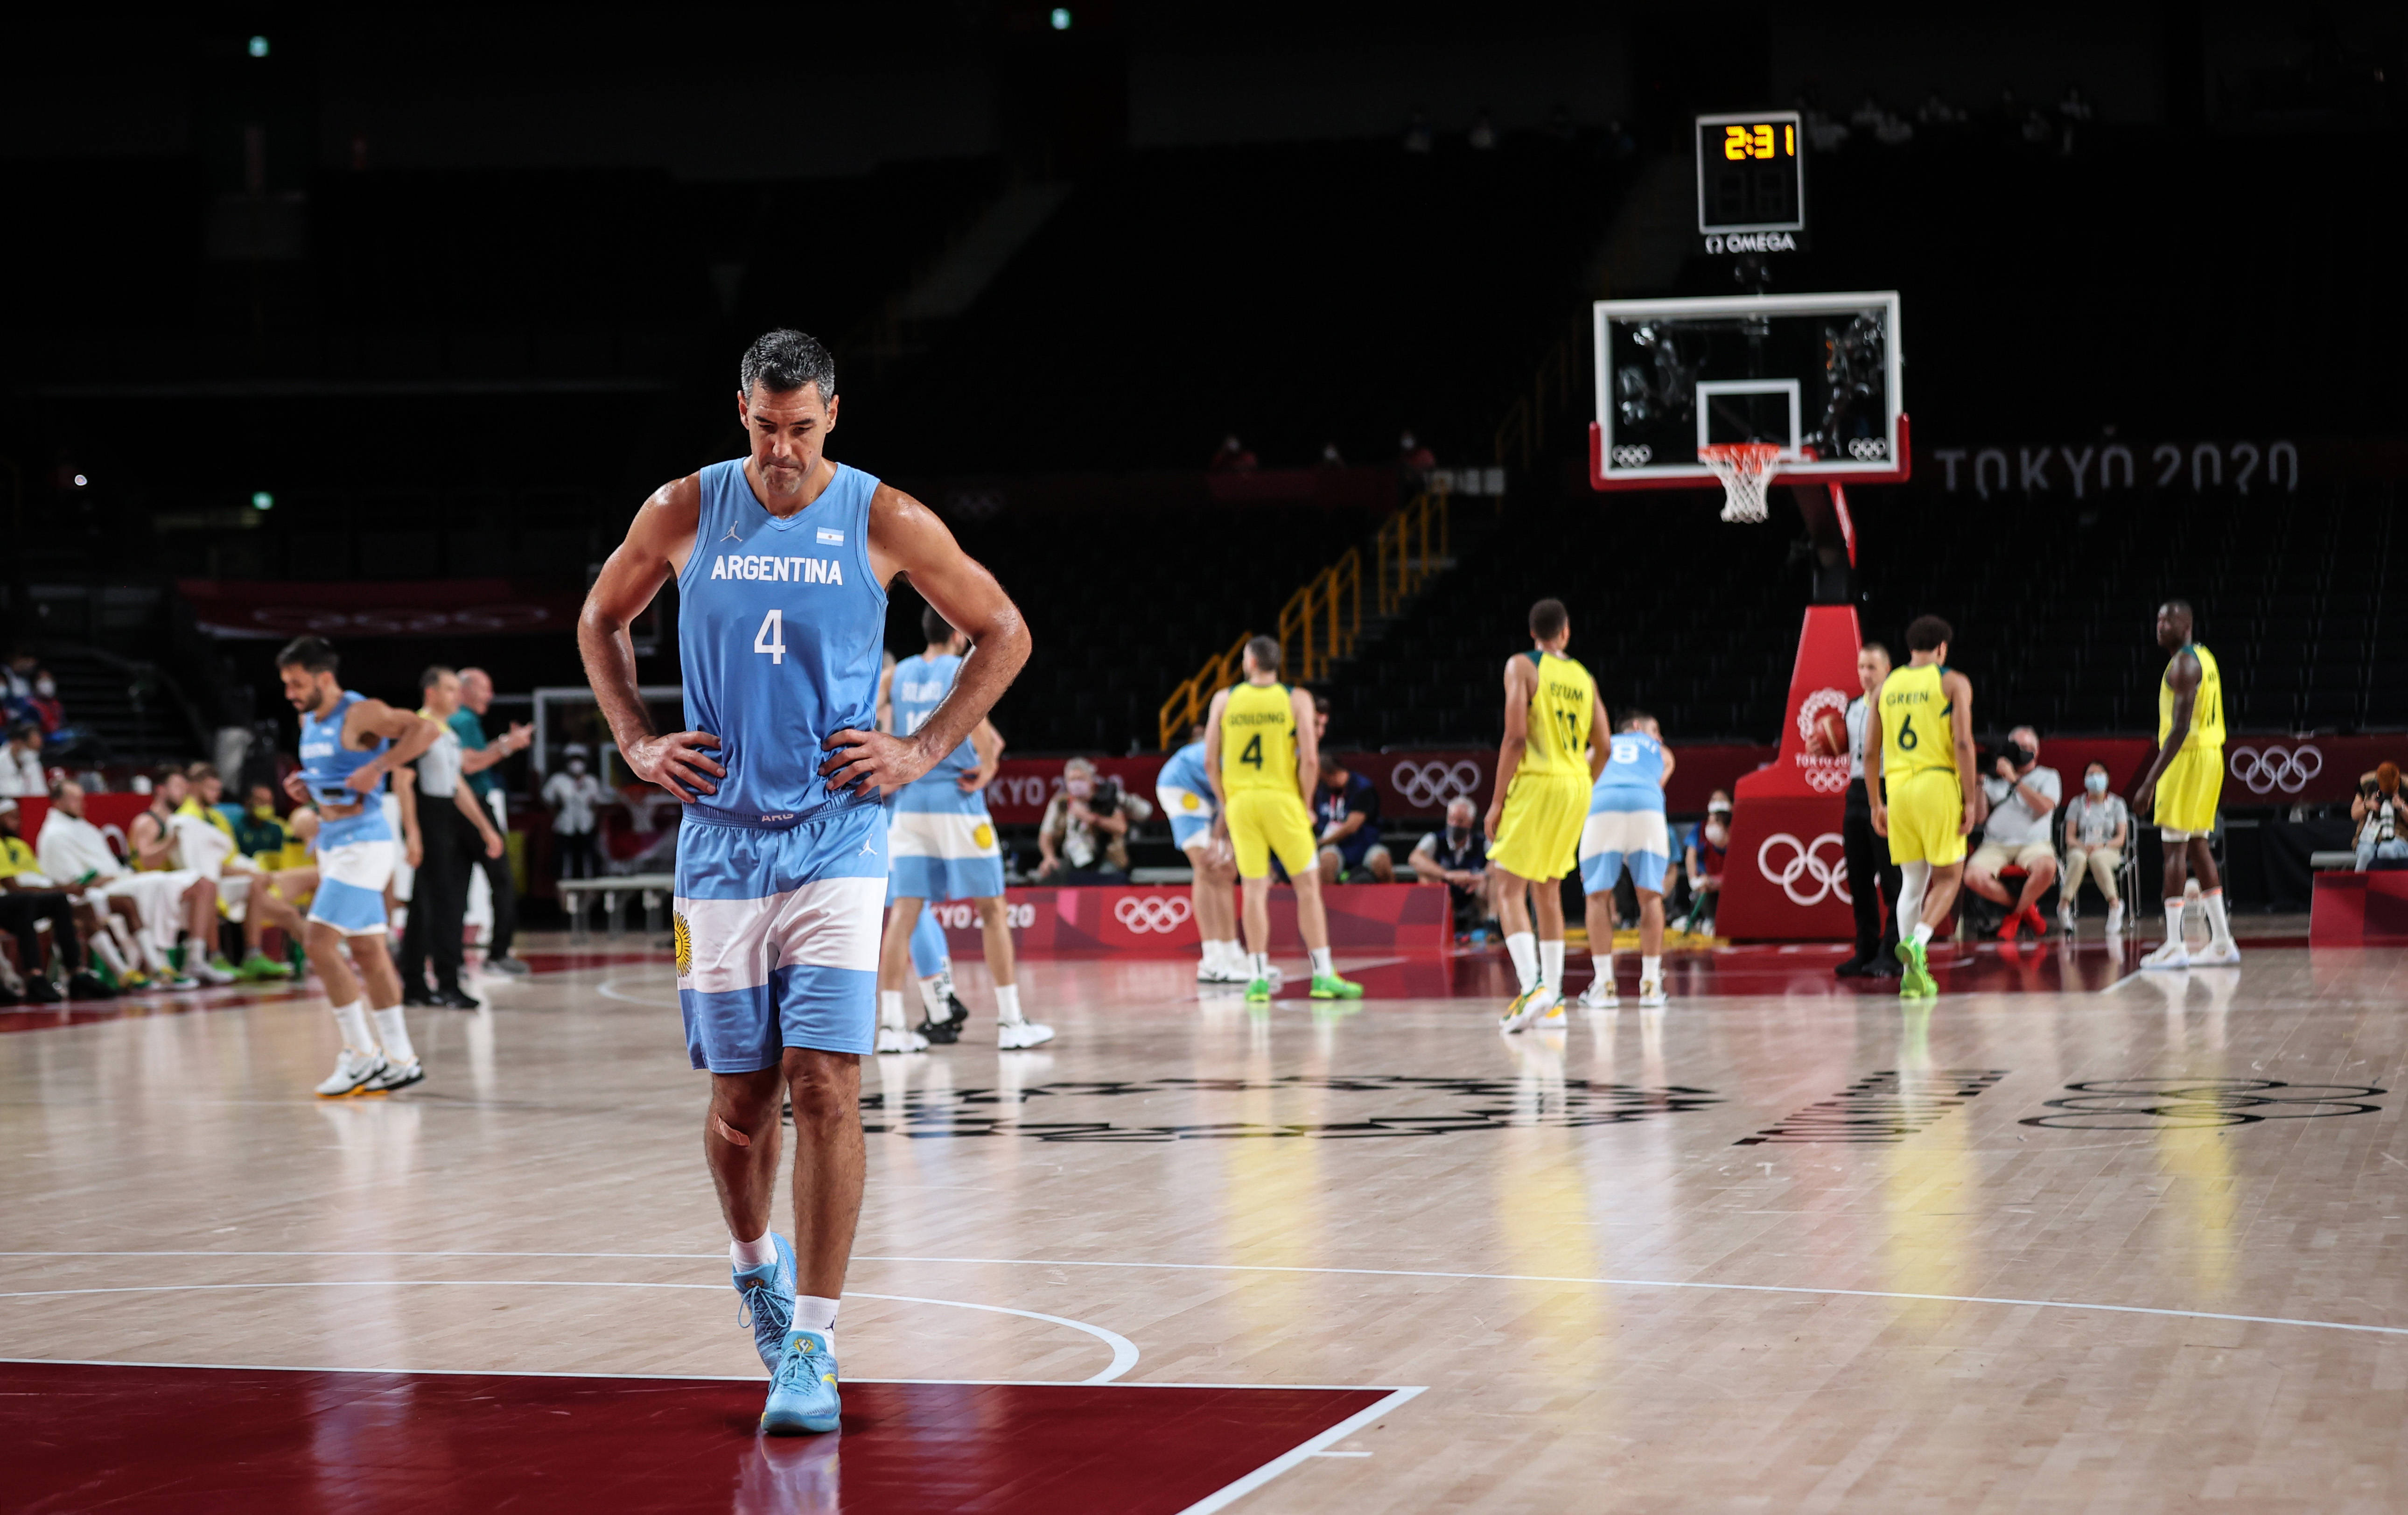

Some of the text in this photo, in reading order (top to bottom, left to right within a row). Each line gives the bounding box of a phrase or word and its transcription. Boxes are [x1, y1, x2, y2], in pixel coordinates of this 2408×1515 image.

[1725, 124, 1795, 160] 2:31
[1727, 232, 1796, 253] OMEGA
[1934, 442, 2298, 499] TOKYO 2020
[711, 555, 843, 586] ARGENTINA
[754, 609, 786, 665] 4
[1886, 692, 1928, 706] GREEN
[1229, 712, 1285, 726] GOULDING
[1897, 714, 1918, 751] 6
[1239, 733, 1263, 771] 4
[1612, 743, 1639, 764] 8
[987, 776, 1046, 807] KYO
